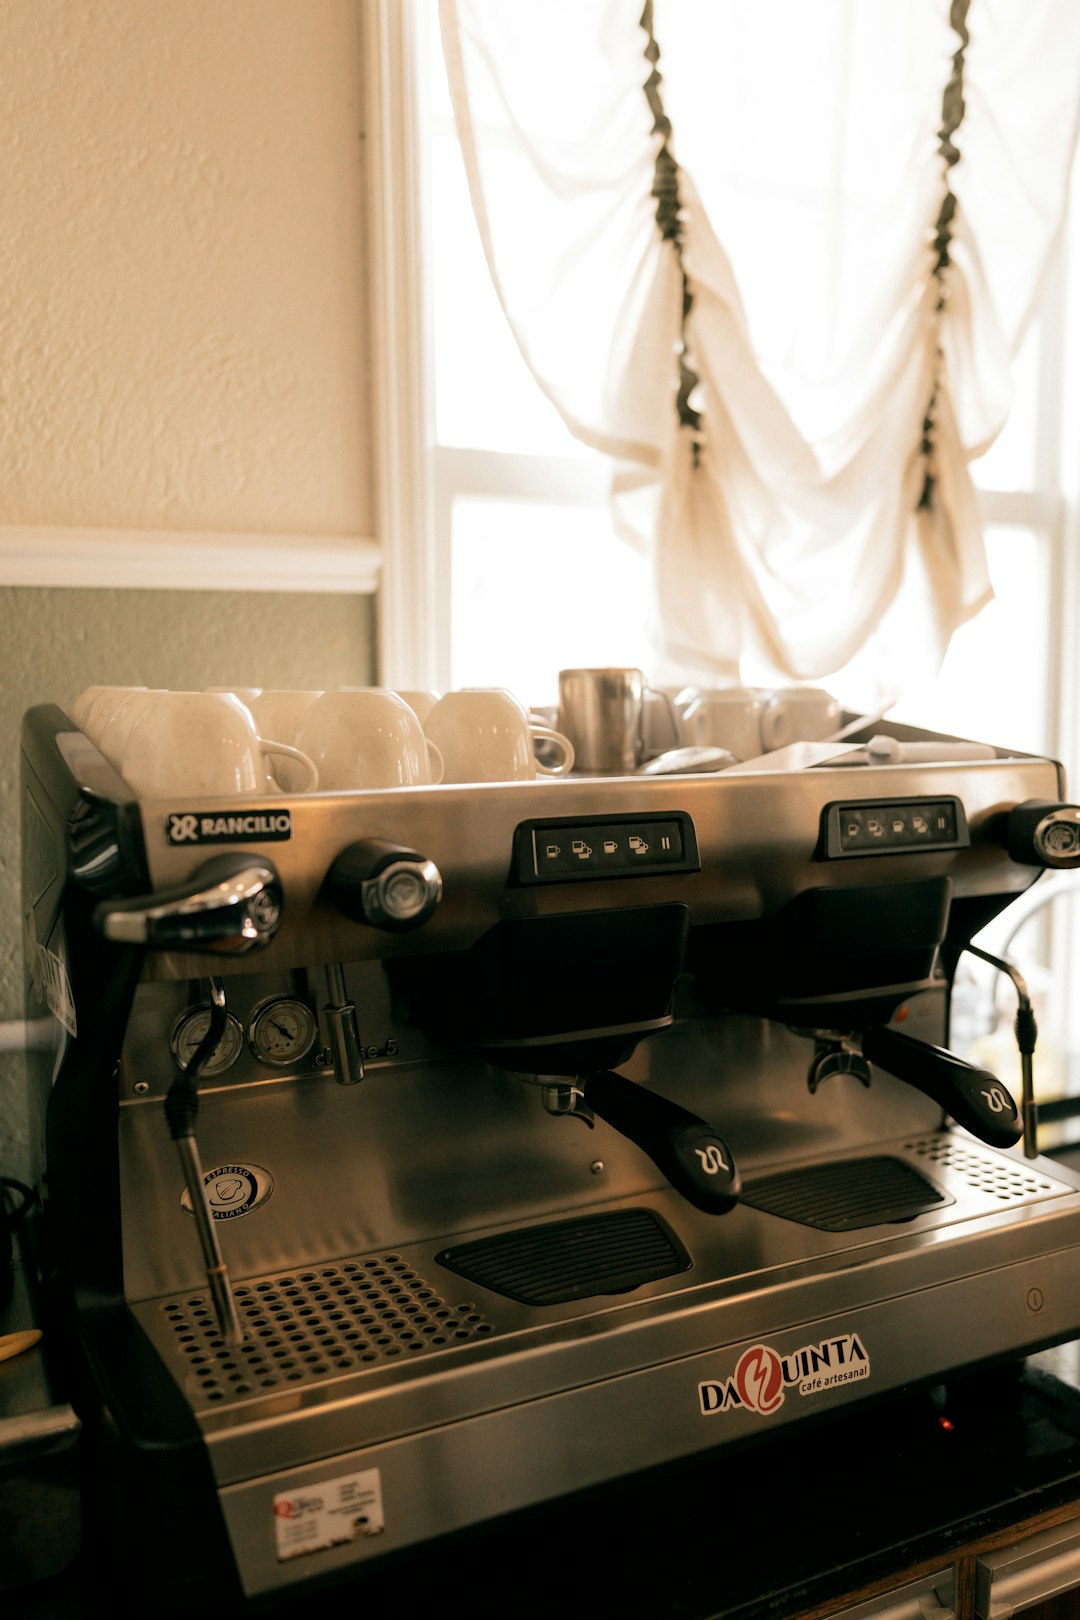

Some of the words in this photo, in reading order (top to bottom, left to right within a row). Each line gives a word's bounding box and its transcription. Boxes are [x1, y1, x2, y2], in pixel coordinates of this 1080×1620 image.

[201, 815, 291, 835] RANCILIO
[386, 1038, 399, 1055] 5
[206, 1167, 250, 1181] ESPRESSO
[212, 1203, 249, 1219] ALIANO
[802, 1378, 822, 1392] café
[825, 1366, 867, 1384] artesanal
